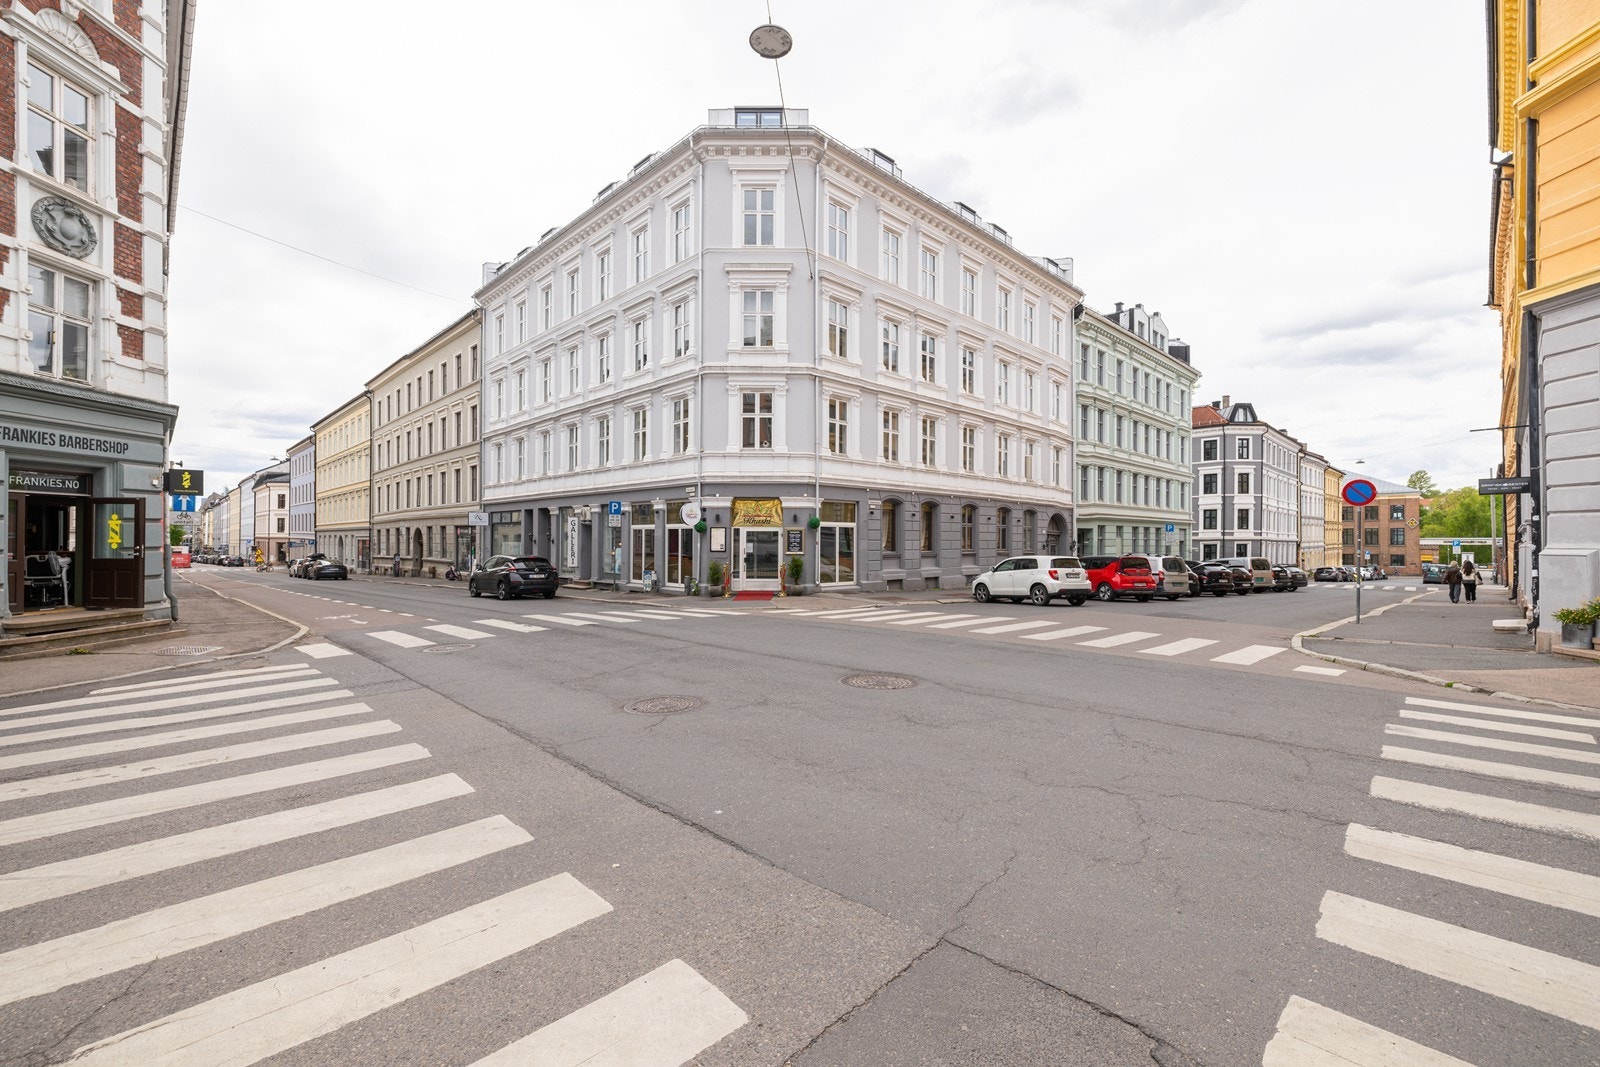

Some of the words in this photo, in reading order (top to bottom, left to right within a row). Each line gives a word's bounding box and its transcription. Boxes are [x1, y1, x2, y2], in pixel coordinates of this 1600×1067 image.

[59, 434, 129, 455] BARBERSHOP
[9, 475, 80, 489] FRANKIES.NO
[611, 502, 619, 513] P
